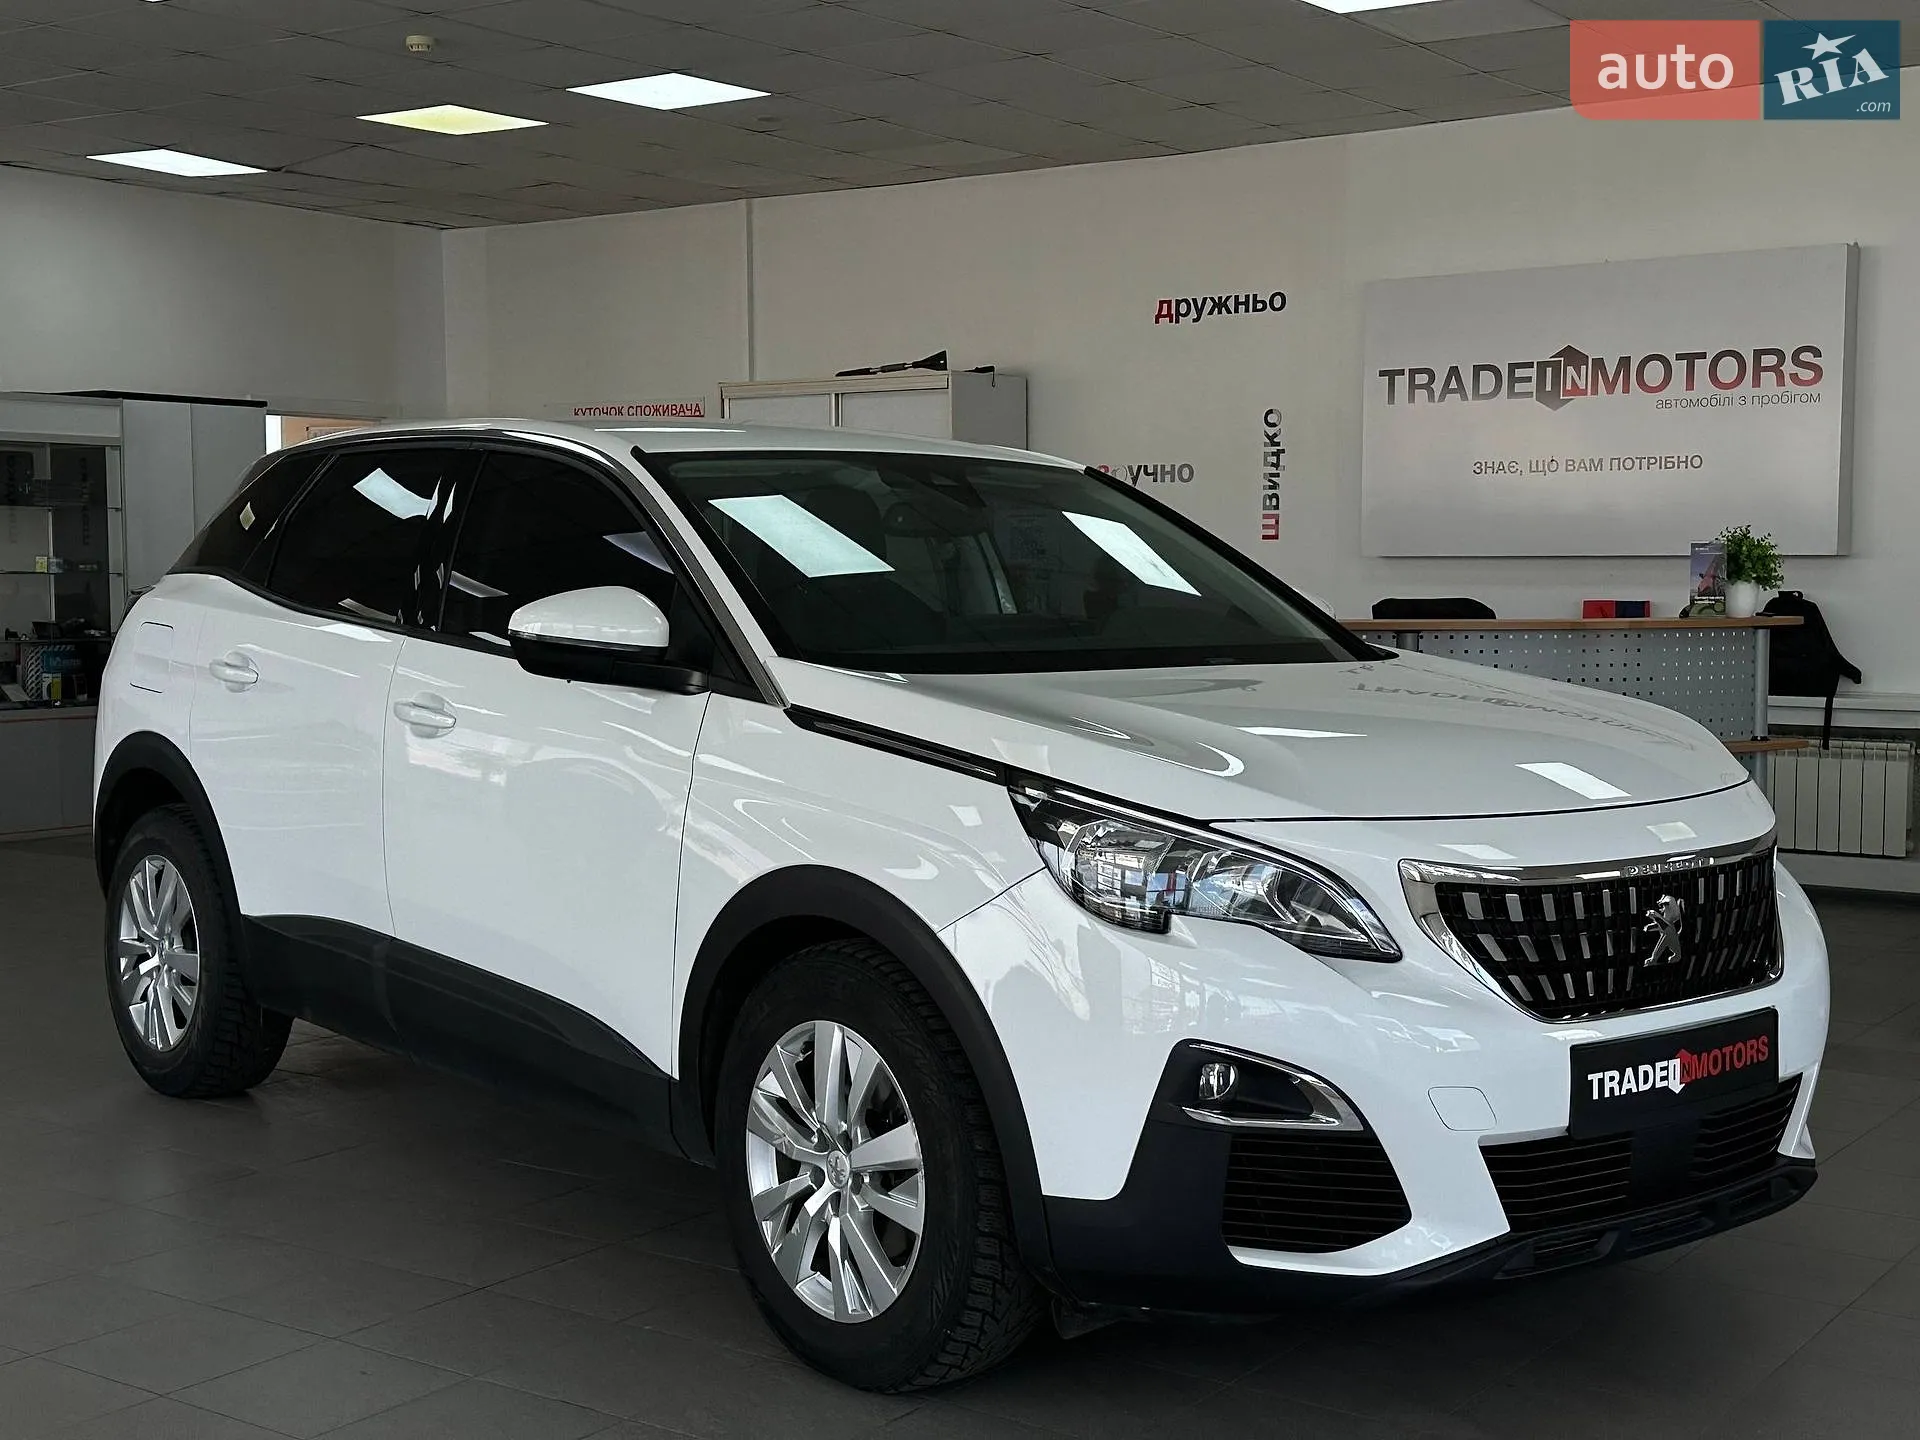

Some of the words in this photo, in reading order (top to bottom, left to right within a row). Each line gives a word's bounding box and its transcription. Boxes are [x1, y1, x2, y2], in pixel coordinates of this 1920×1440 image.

[1154, 291, 1287, 324] дружньо
[627, 403, 703, 417] СПОЖИВАЧА
[1655, 393, 1734, 410] автомобілі
[1738, 395, 1748, 406] з
[1751, 391, 1822, 408] пробігом
[1261, 408, 1286, 540] швидко
[1472, 460, 1523, 477] ЗНАЄ,
[1528, 457, 1559, 477] ЩО
[1565, 457, 1604, 473] ВАМ
[1609, 454, 1703, 472] ПОТРІБНО
